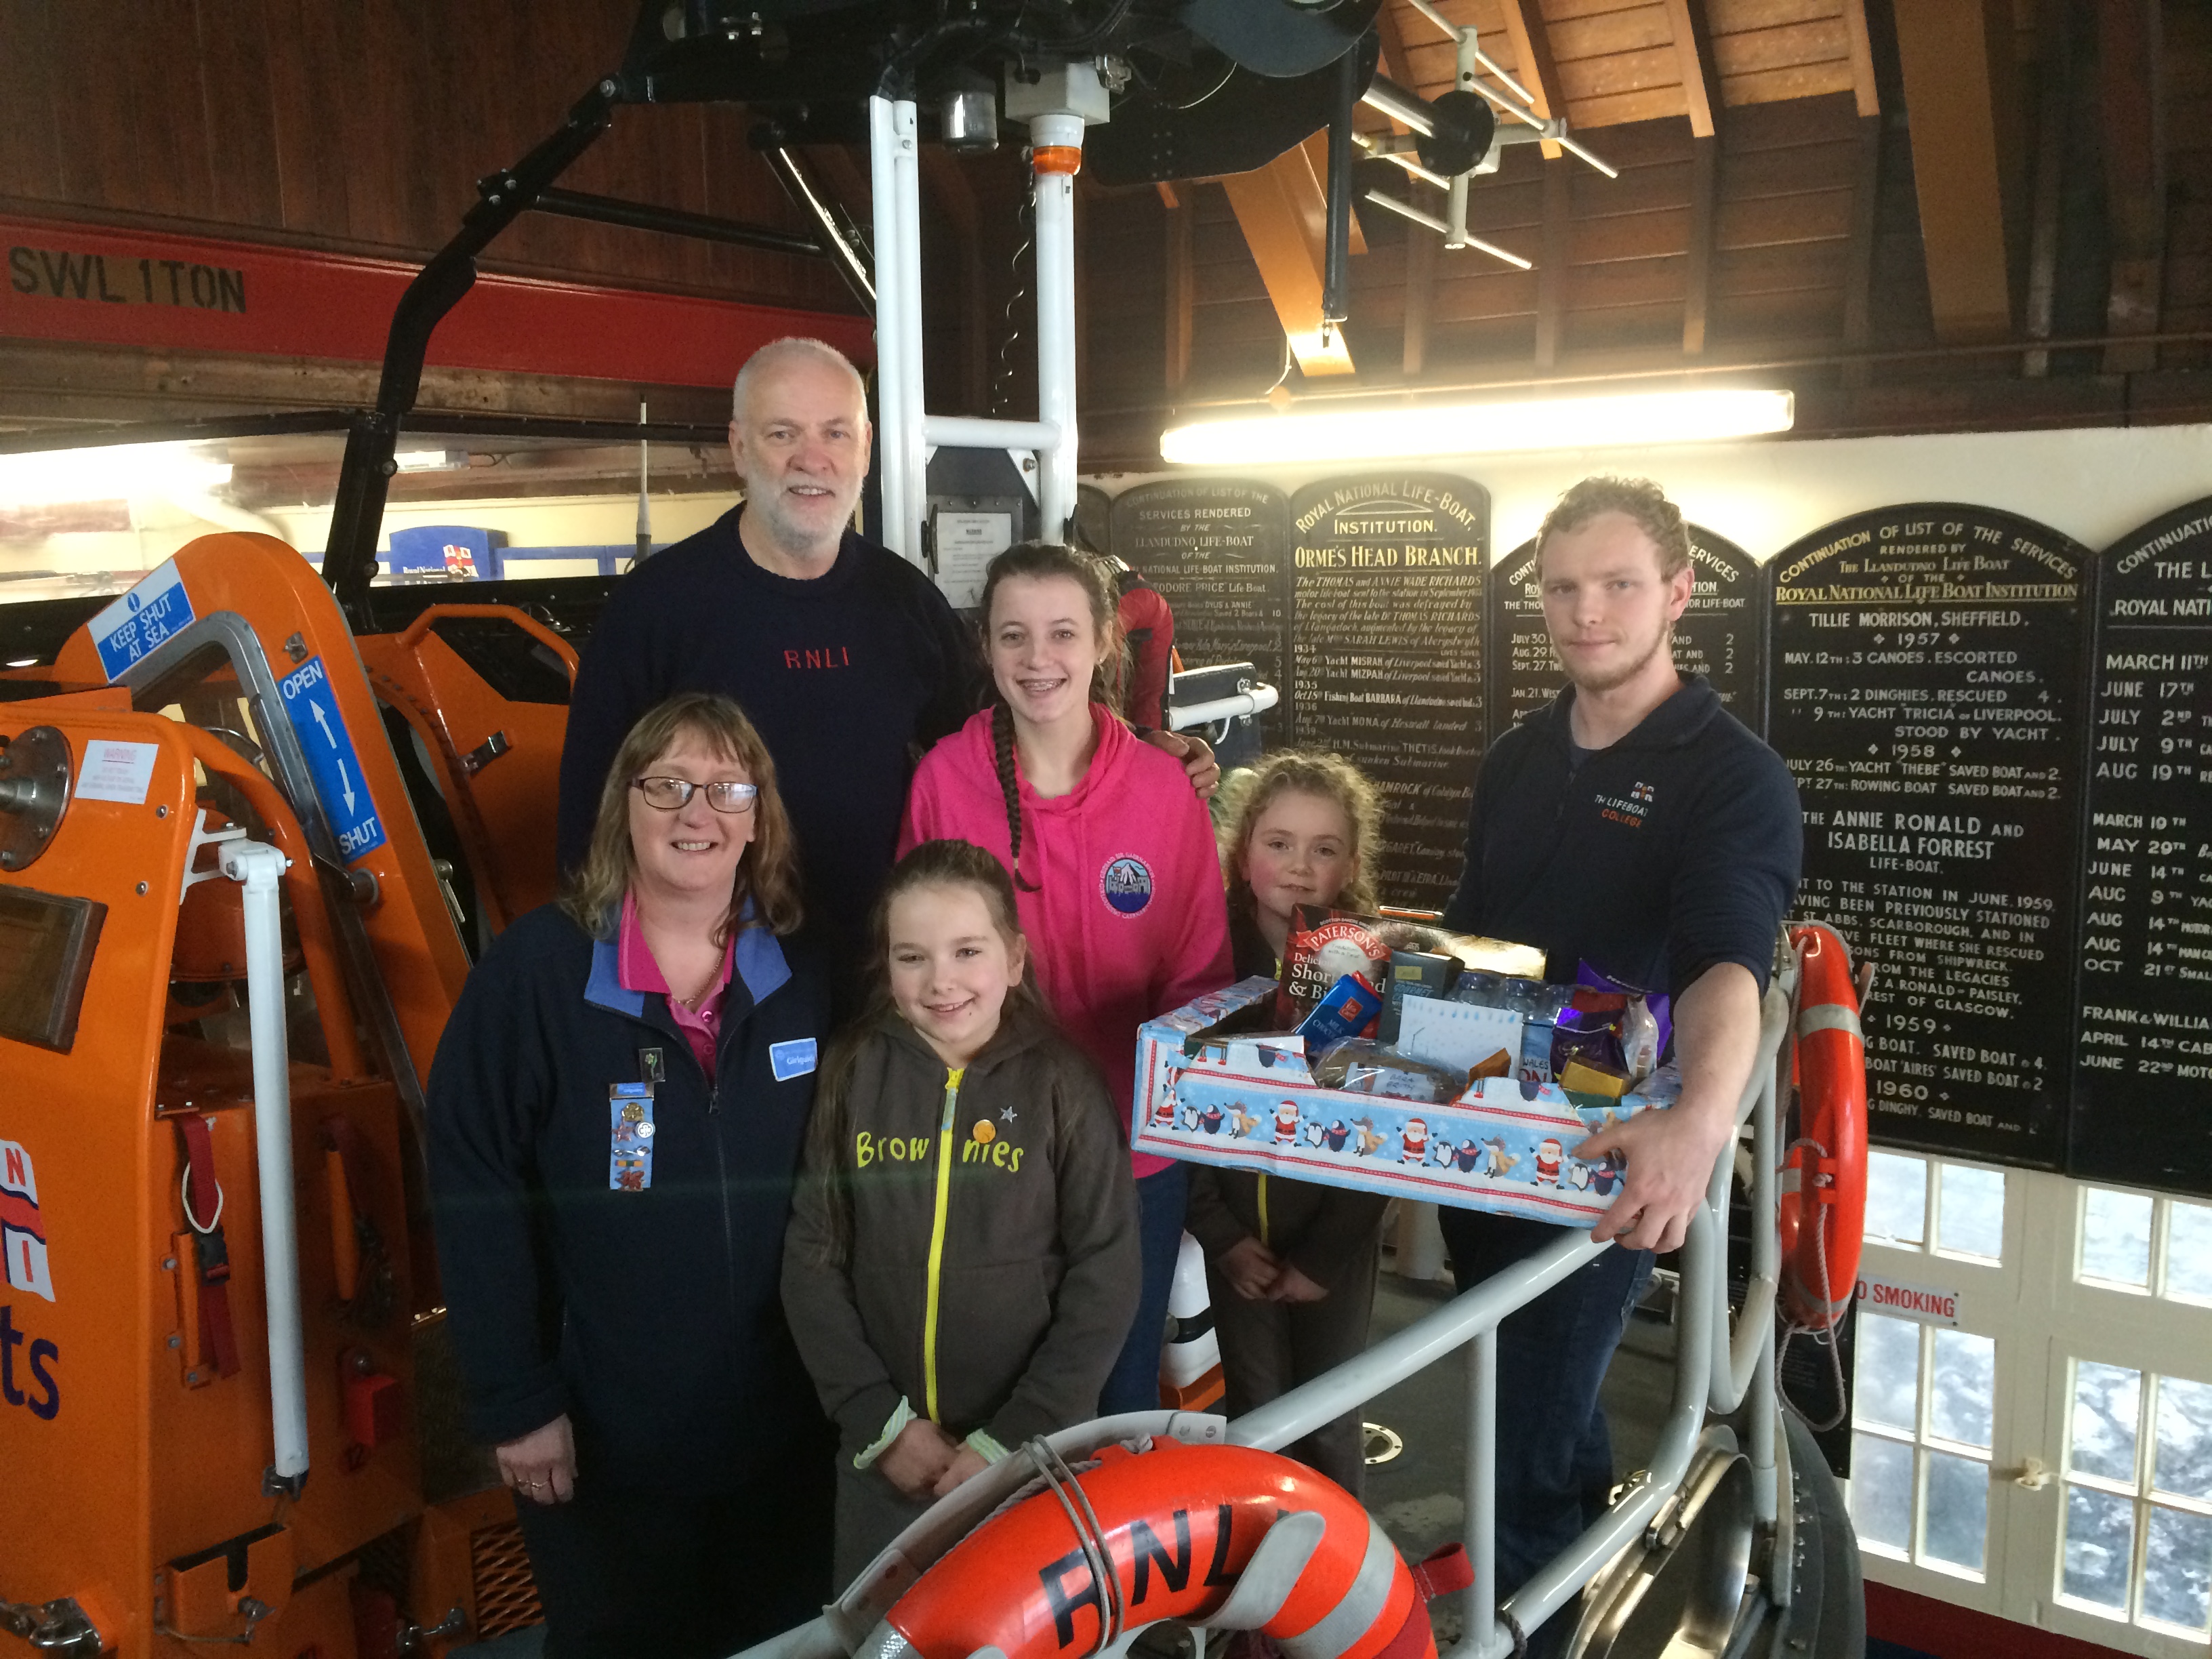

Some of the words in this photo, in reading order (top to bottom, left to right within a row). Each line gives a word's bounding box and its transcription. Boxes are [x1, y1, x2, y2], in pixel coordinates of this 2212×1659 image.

[8, 246, 127, 303] SWL
[159, 260, 247, 314] TON
[1212, 488, 1232, 497] LIST
[1252, 491, 1269, 504] THE
[1139, 509, 1191, 520] SERVICES
[1194, 508, 1251, 518] RENDERED
[1295, 498, 1334, 534] ROYAL
[1334, 483, 1397, 506] NATIONAL
[1334, 519, 1437, 535] INSTITUTION.
[1200, 536, 1254, 547] LIFE-BOAT
[1879, 544, 1947, 555] RENDERED
[1950, 544, 1966, 554] BY
[1294, 546, 1347, 568] ORME'S
[1351, 546, 1398, 567] HEAD
[1404, 546, 1482, 567] BRANCH.
[1779, 530, 1871, 583] CONTINUATION
[1879, 525, 1900, 539] OF
[1905, 522, 1932, 535] LIST
[1942, 522, 1963, 537] OF
[1973, 525, 2003, 545] THE
[2009, 537, 2078, 581] SERVICES
[1183, 565, 1199, 574] LIFE
[1203, 565, 1223, 573] BOAT
[2154, 561, 2192, 579] THE
[1316, 577, 1354, 587] THOMAS
[1404, 576, 1427, 587] WADE
[1429, 575, 1481, 586] RICHARDS
[1898, 573, 1915, 583] OF
[1923, 573, 1946, 583] THE
[1776, 586, 1828, 602] ROYAL
[1829, 584, 1904, 601] NATIONAL
[1905, 584, 1940, 600] LIFE
[1942, 583, 1982, 599] BOAT
[1985, 581, 2079, 599] INSTITUTION
[1504, 601, 1521, 610] THE
[2114, 598, 2169, 617] ROYAL
[110, 617, 137, 652] KEEP
[139, 593, 172, 628] SHUT
[1430, 611, 1481, 621] RICHARDS
[1809, 613, 1851, 628] TILLIE
[1859, 612, 1939, 628] MORRISON,
[128, 638, 142, 662] AT
[148, 623, 171, 649] SEA
[1511, 633, 1530, 644] JULY
[1726, 633, 1734, 645] 2
[1897, 632, 1941, 648] 1957
[1294, 644, 1316, 653] 1934
[1685, 650, 1704, 659] AND
[1726, 647, 1734, 659] 2
[1851, 651, 1863, 665] 3
[1935, 651, 2018, 664] ESCORTED
[2106, 654, 2175, 670] MARCH
[1351, 669, 1382, 679] MIZPAH
[1692, 663, 1711, 674] AND
[1725, 662, 1734, 674] 2
[282, 660, 323, 701] OPEN
[1851, 689, 1860, 701] 2
[1938, 689, 2008, 703] RESCUED
[2101, 681, 2144, 698] JUNE
[1366, 693, 1401, 704] BARBARA
[1848, 707, 1896, 720] YACHT
[2099, 709, 2142, 725] JULY
[1894, 725, 1949, 739] STOOD
[1959, 727, 1982, 740] BY
[1992, 727, 2049, 741] YACHT
[2096, 736, 2139, 752] JULY
[1891, 745, 1936, 762] 1958
[1848, 760, 1891, 775] YACHT
[1948, 764, 1989, 778] SAVED
[1992, 765, 2023, 779] BOAT
[2095, 762, 2138, 779] AUG
[1850, 779, 1901, 793] ROWING
[1904, 781, 1938, 794] BOAT
[1948, 783, 1990, 797] SAVED
[1992, 783, 2023, 798] BOAT
[1802, 811, 1824, 825] THE
[1832, 811, 1884, 829] ANNIE
[1894, 813, 1982, 835] RONALD
[1991, 824, 2024, 838] AND
[2093, 813, 2143, 829] MARCH
[339, 817, 379, 855] SHUT
[1828, 831, 1910, 854] ISABELLA
[1917, 836, 1995, 860] FORREST
[2097, 837, 2139, 853] MAY
[2088, 861, 2132, 877] JUNE
[1816, 880, 1833, 891] TO
[1841, 880, 1864, 894] THE
[1873, 883, 1933, 900] STATION
[1942, 888, 1959, 902] IN
[2088, 885, 2126, 903] AUG
[1840, 897, 1875, 912] BEEN
[1885, 901, 1970, 921] PREVIOUSLY
[1975, 911, 2051, 929] STATIONED
[2087, 912, 2123, 926] AUG
[1310, 926, 1380, 957] PATERSON'S
[1980, 928, 2011, 941] AND
[2018, 932, 2034, 943] IN
[1870, 933, 1908, 947] FLEET
[1914, 936, 1955, 953] WHERE
[1959, 941, 1980, 955] SHE
[1986, 943, 2045, 961] RESCUED
[2084, 936, 2121, 952] AUG
[1294, 952, 1333, 966] Delicio
[1889, 949, 1926, 963] FROM
[2083, 958, 2124, 973] OCT
[1908, 965, 1936, 979] THE
[1945, 968, 2010, 988] LEGACIES
[1289, 981, 1307, 997] &
[1393, 983, 1434, 997] GOURMET
[1884, 977, 1894, 989] A
[1899, 979, 1955, 996] RONALD
[1907, 996, 1927, 1007] OF
[2082, 1006, 2138, 1023] FRANK
[1886, 1014, 1937, 1035] 1959
[2081, 1031, 2129, 1047] APRIL
[1933, 1043, 1975, 1062] SAVED
[1980, 1048, 2016, 1067] BOAT
[2080, 1055, 2125, 1070] JUNE
[1523, 1058, 1549, 1070] WALES
[1865, 1056, 1897, 1071] BOAT
[1943, 1066, 1982, 1084] SAVED
[1987, 1071, 2020, 1088] BOAT
[2032, 1077, 2043, 1092] 2
[1876, 1079, 1929, 1101] 1960
[1928, 1106, 1962, 1123] SAVED
[1966, 1112, 1994, 1128] BOAT
[857, 1131, 930, 1168] Brow
[962, 1139, 1024, 1172] nies
[1855, 1280, 1868, 1300] O
[1873, 1284, 1955, 1317] SMOKING
